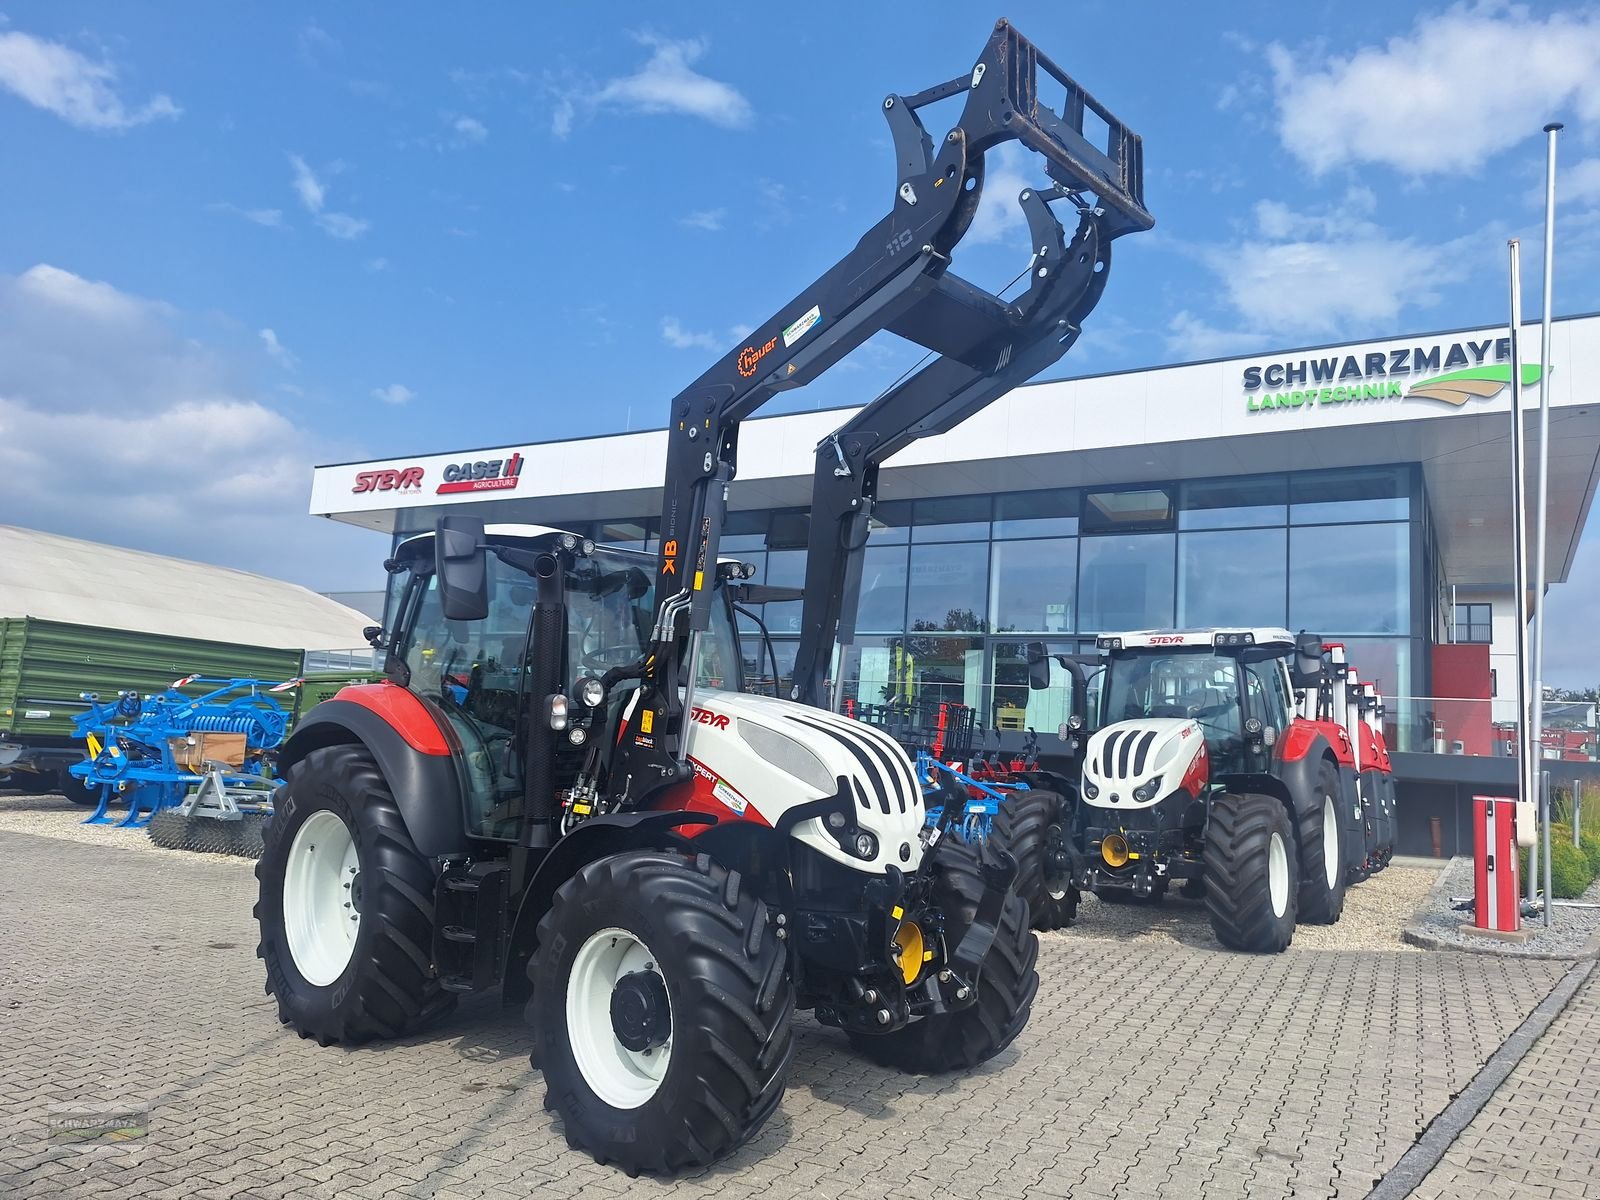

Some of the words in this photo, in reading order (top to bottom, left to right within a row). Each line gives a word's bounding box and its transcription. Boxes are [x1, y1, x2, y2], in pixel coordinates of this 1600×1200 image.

[744, 336, 778, 369] hauer
[1243, 337, 1511, 390] SCHWARZMAYR
[1247, 381, 1402, 412] LANDTECHNIK
[352, 466, 425, 494] STEYR
[443, 459, 503, 483] CASE
[473, 479, 515, 489] AGRICULTURE
[1149, 636, 1185, 645] STEYR
